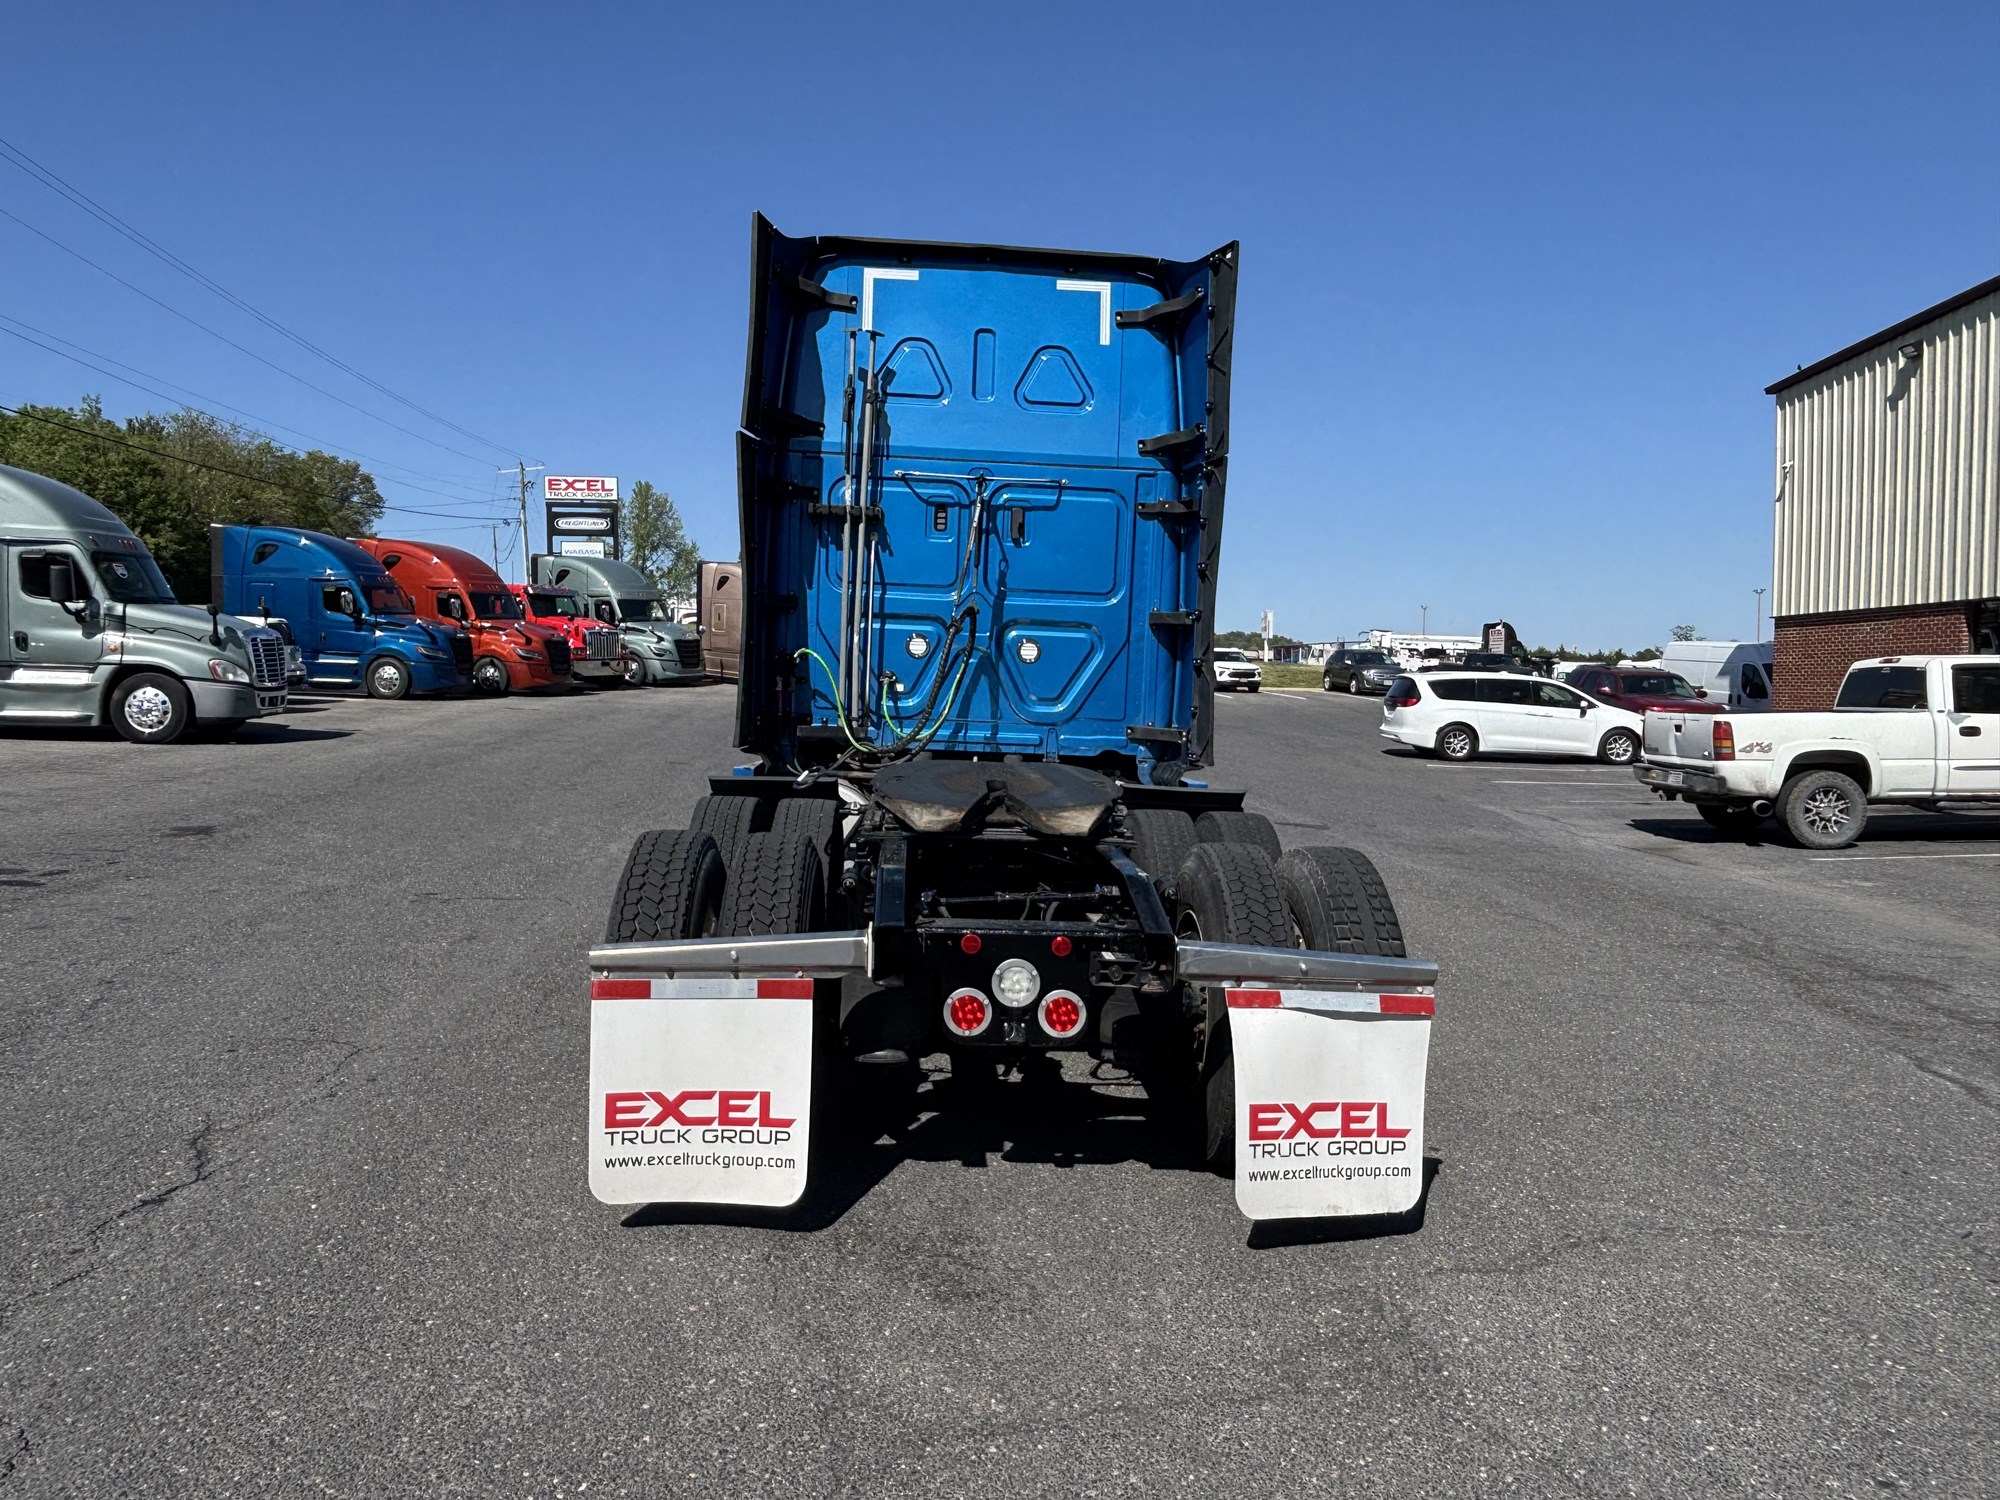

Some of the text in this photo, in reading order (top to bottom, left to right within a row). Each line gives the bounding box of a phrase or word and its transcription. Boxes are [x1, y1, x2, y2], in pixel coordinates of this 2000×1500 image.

[547, 478, 615, 492] EXCEL
[604, 1090, 797, 1129] EXCEL
[1249, 1102, 1412, 1141] EXCEL
[604, 1129, 791, 1146] TRUCK GROUP
[1249, 1140, 1406, 1159] TRUCK GROUP
[604, 1153, 796, 1170] www.exceltruckgroup.com
[1248, 1164, 1411, 1182] www.exceltruckgroup.com
